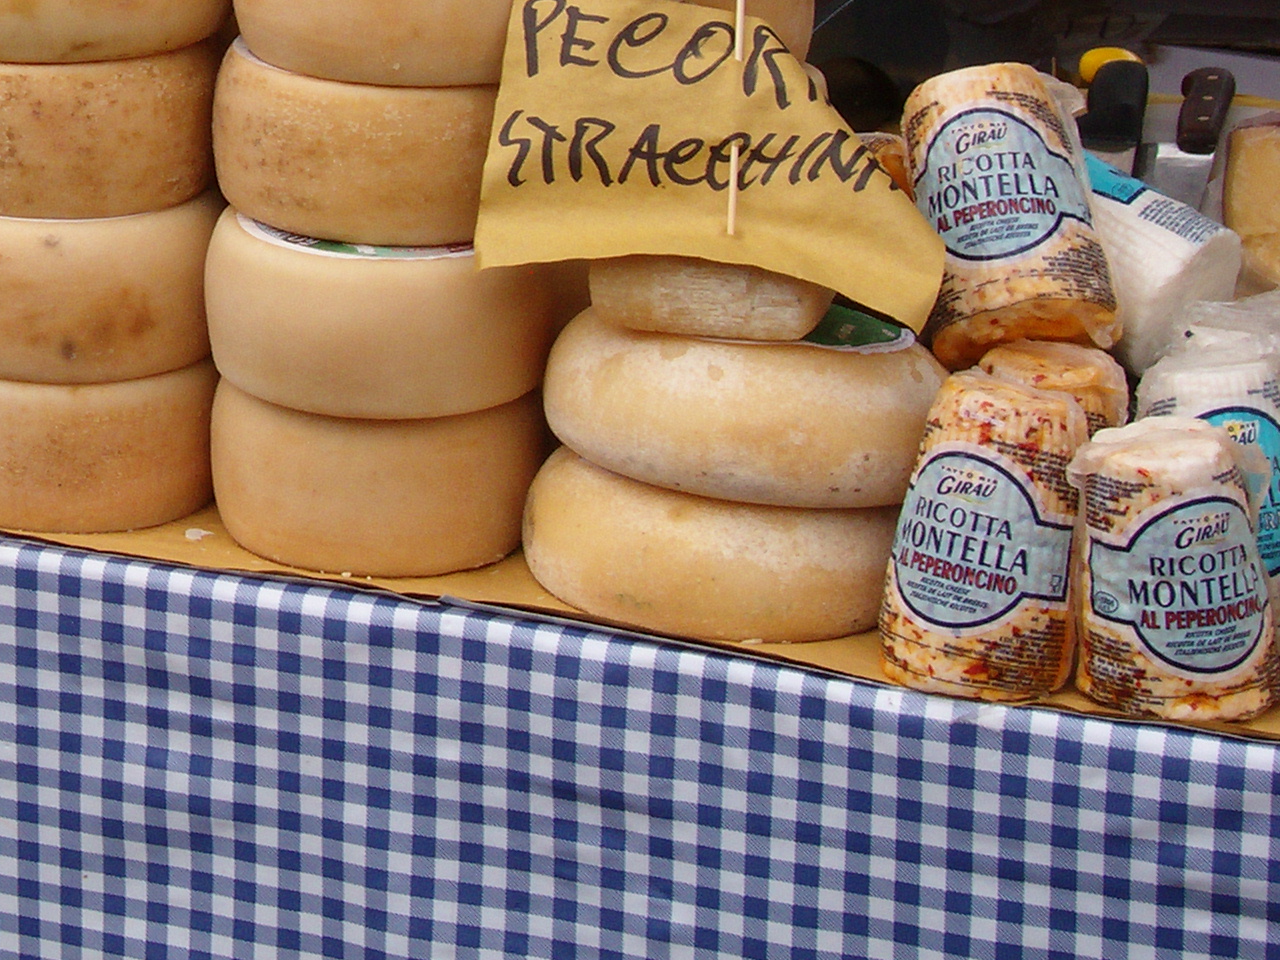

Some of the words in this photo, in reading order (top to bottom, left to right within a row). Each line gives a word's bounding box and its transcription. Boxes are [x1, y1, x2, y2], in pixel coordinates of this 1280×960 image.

[937, 151, 1037, 185] RICOTTA
[927, 175, 1060, 220] MONTELLA
[954, 197, 1057, 228] PEPERONCINO
[915, 496, 1013, 541] RICOTTA
[902, 517, 1029, 576] MONTELLA
[1149, 543, 1247, 577] RICOTTA
[910, 551, 1017, 596] PEPERONCINO
[1127, 562, 1259, 608] MONTELLA
